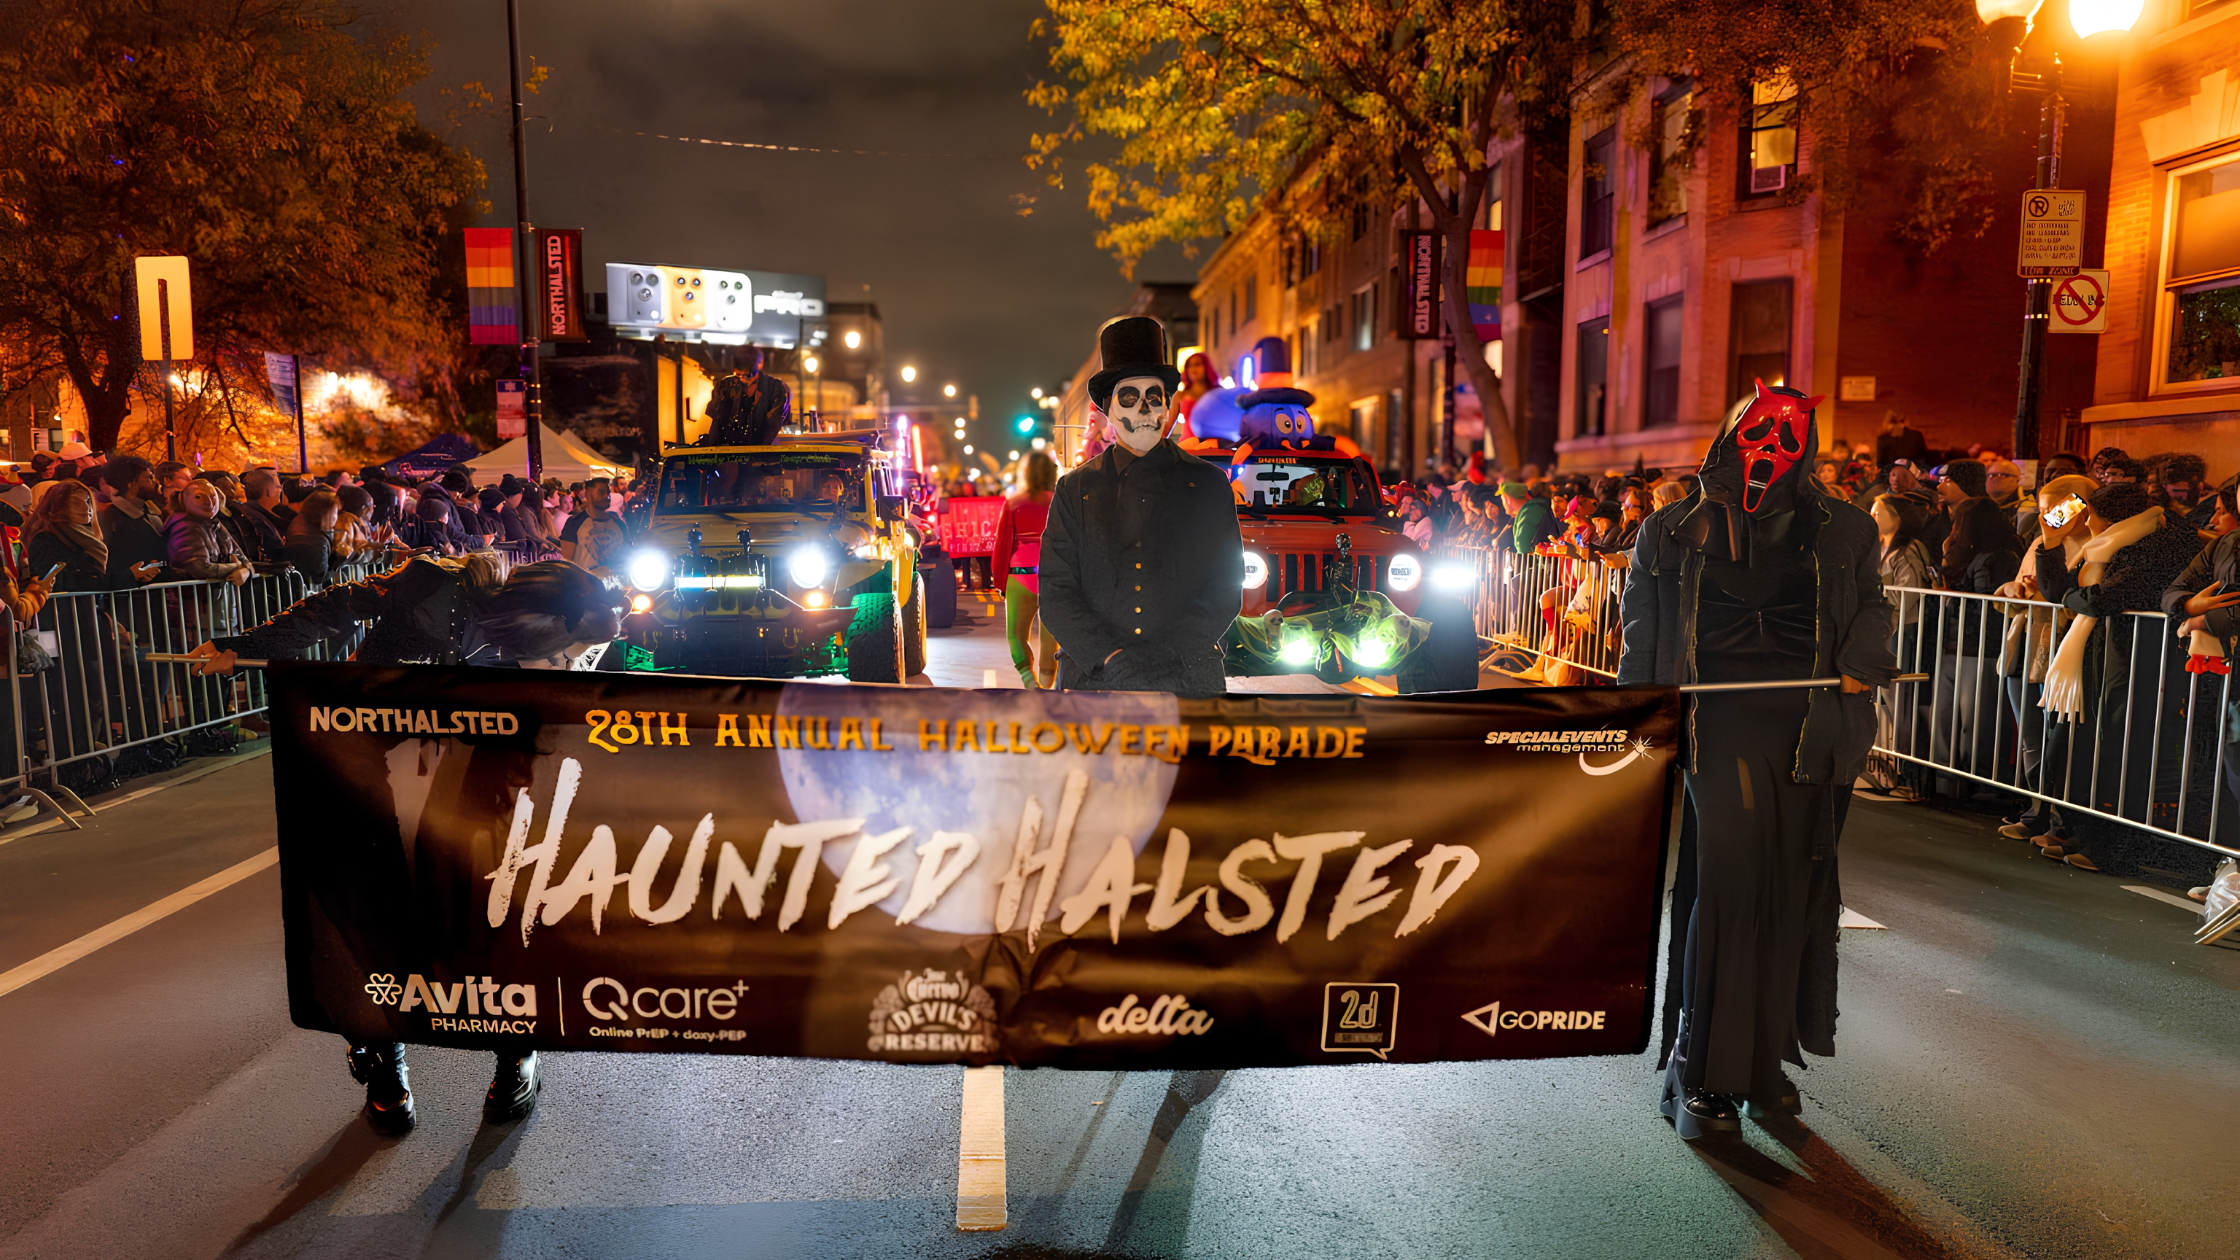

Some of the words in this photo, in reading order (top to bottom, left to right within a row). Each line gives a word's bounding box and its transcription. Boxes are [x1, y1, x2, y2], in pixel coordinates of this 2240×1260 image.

[546, 235, 566, 335] NORTHALSTED
[309, 706, 519, 736] NORTHALSTED
[586, 709, 690, 753] 28TH
[714, 712, 893, 751] ANNUAL
[918, 718, 1190, 764] HALLOWEEN
[1208, 725, 1367, 766] PARADE
[484, 757, 981, 949] HAUNTED
[993, 768, 1480, 953] HALSTED
[399, 973, 538, 1017] Avita
[1339, 989, 1379, 1029] 2d
[431, 1017, 537, 1034] PHARMACY
[890, 1001, 978, 1033] DEVIL'S
[1097, 993, 1214, 1036] delta
[1500, 1010, 1605, 1032] GOPRIDE
[589, 1026, 634, 1039] Online
[636, 1027, 670, 1040] PrEP
[683, 1029, 748, 1043] doxy-PEP
[884, 1033, 985, 1053] RESERVE
